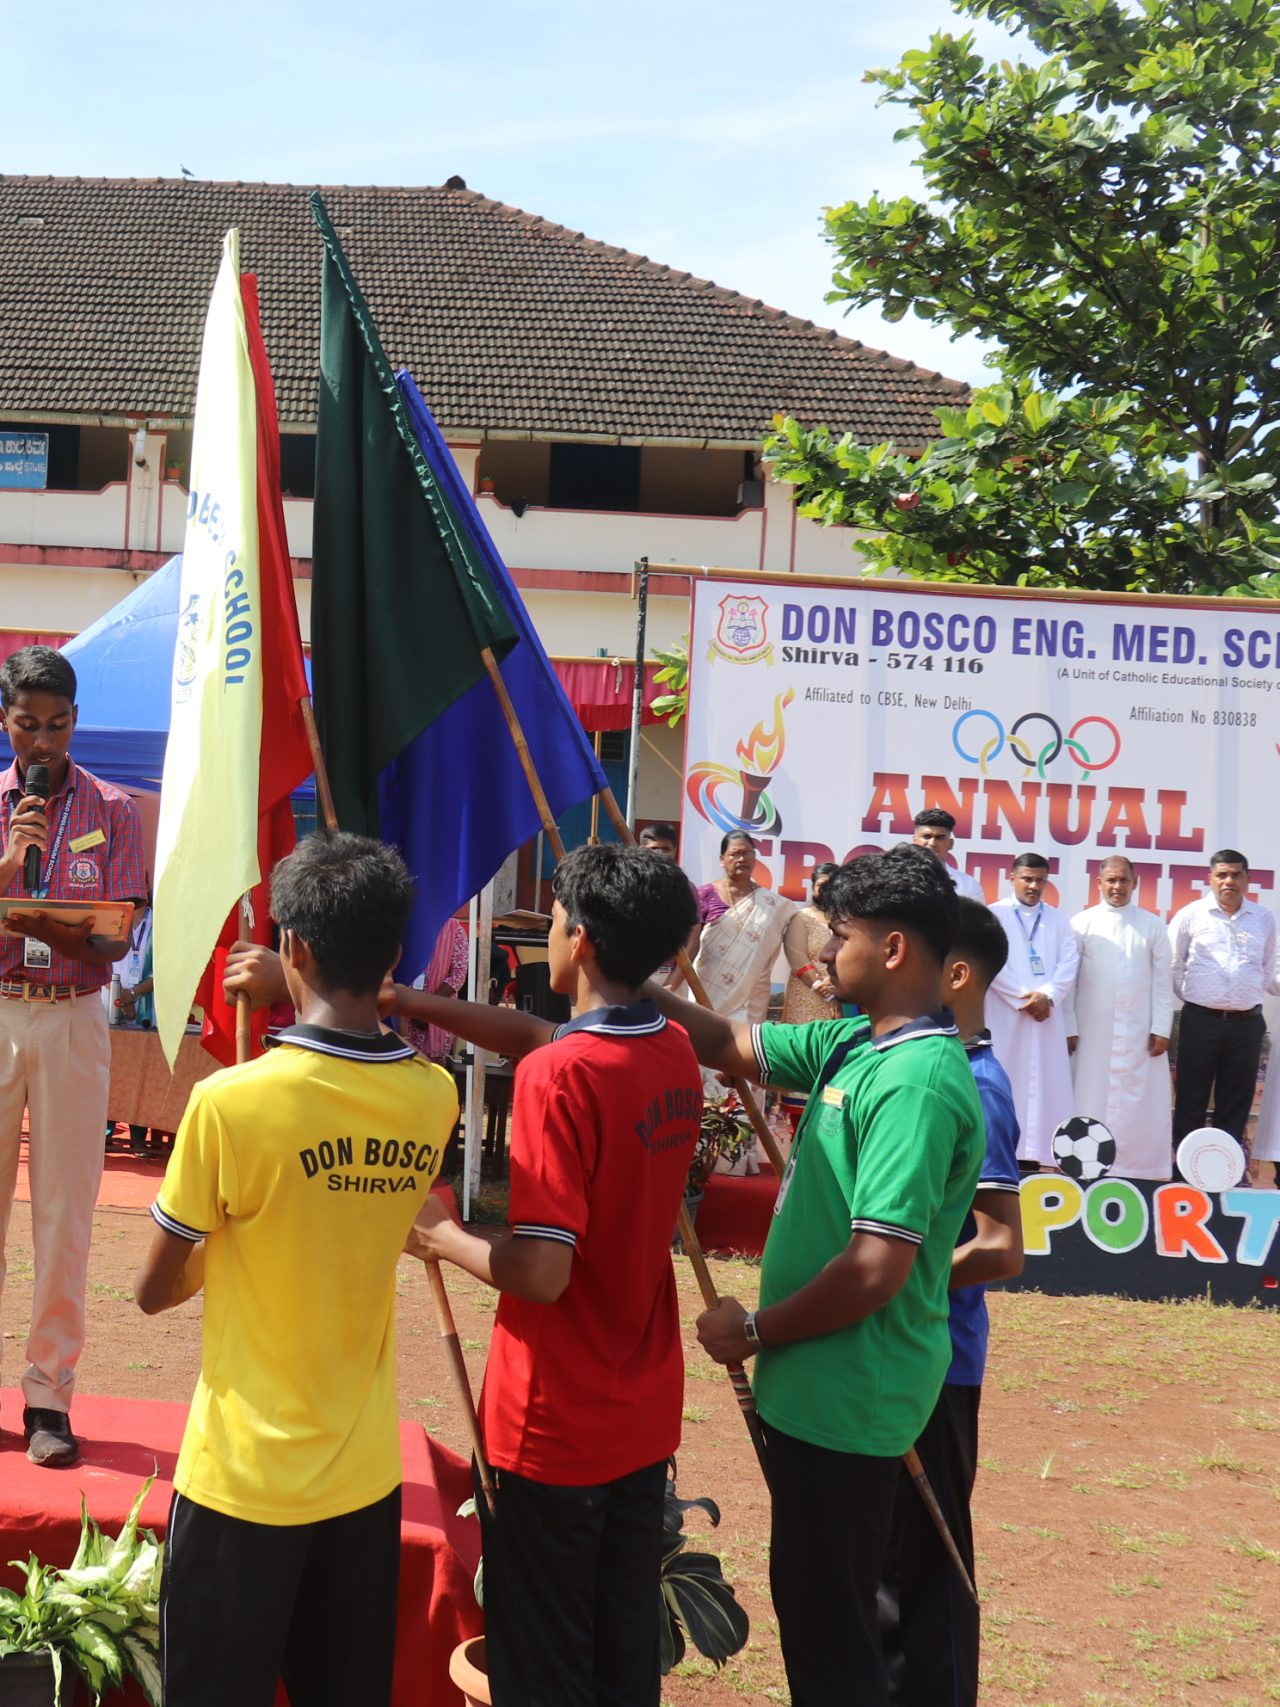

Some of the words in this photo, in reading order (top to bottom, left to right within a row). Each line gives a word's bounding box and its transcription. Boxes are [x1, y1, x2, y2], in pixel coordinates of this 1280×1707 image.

[781, 603, 857, 644] DON
[872, 609, 997, 654] BOSCO
[1012, 617, 1096, 659] ENG.
[1112, 623, 1208, 665] MED.
[782, 646, 859, 667] Shirva
[886, 653, 935, 671] 574
[944, 656, 984, 674] 116
[1073, 669, 1095, 681] Unit
[1098, 670, 1110, 681] of
[1113, 671, 1159, 684] Catholic
[1162, 673, 1228, 688] Educational
[1231, 676, 1273, 692] Society
[805, 686, 853, 704] Affiliated
[860, 691, 871, 705] to
[877, 691, 908, 708] CBSE,
[914, 693, 937, 709] New
[944, 695, 972, 711] Delhi
[1130, 706, 1184, 724] Affiliation
[1191, 709, 1206, 725] No
[1213, 710, 1257, 727] 830838
[862, 772, 1205, 853] ANNUAL
[299, 1137, 353, 1178] DON
[364, 1138, 439, 1177] BOSCO
[327, 1174, 417, 1194] SHIRVA
